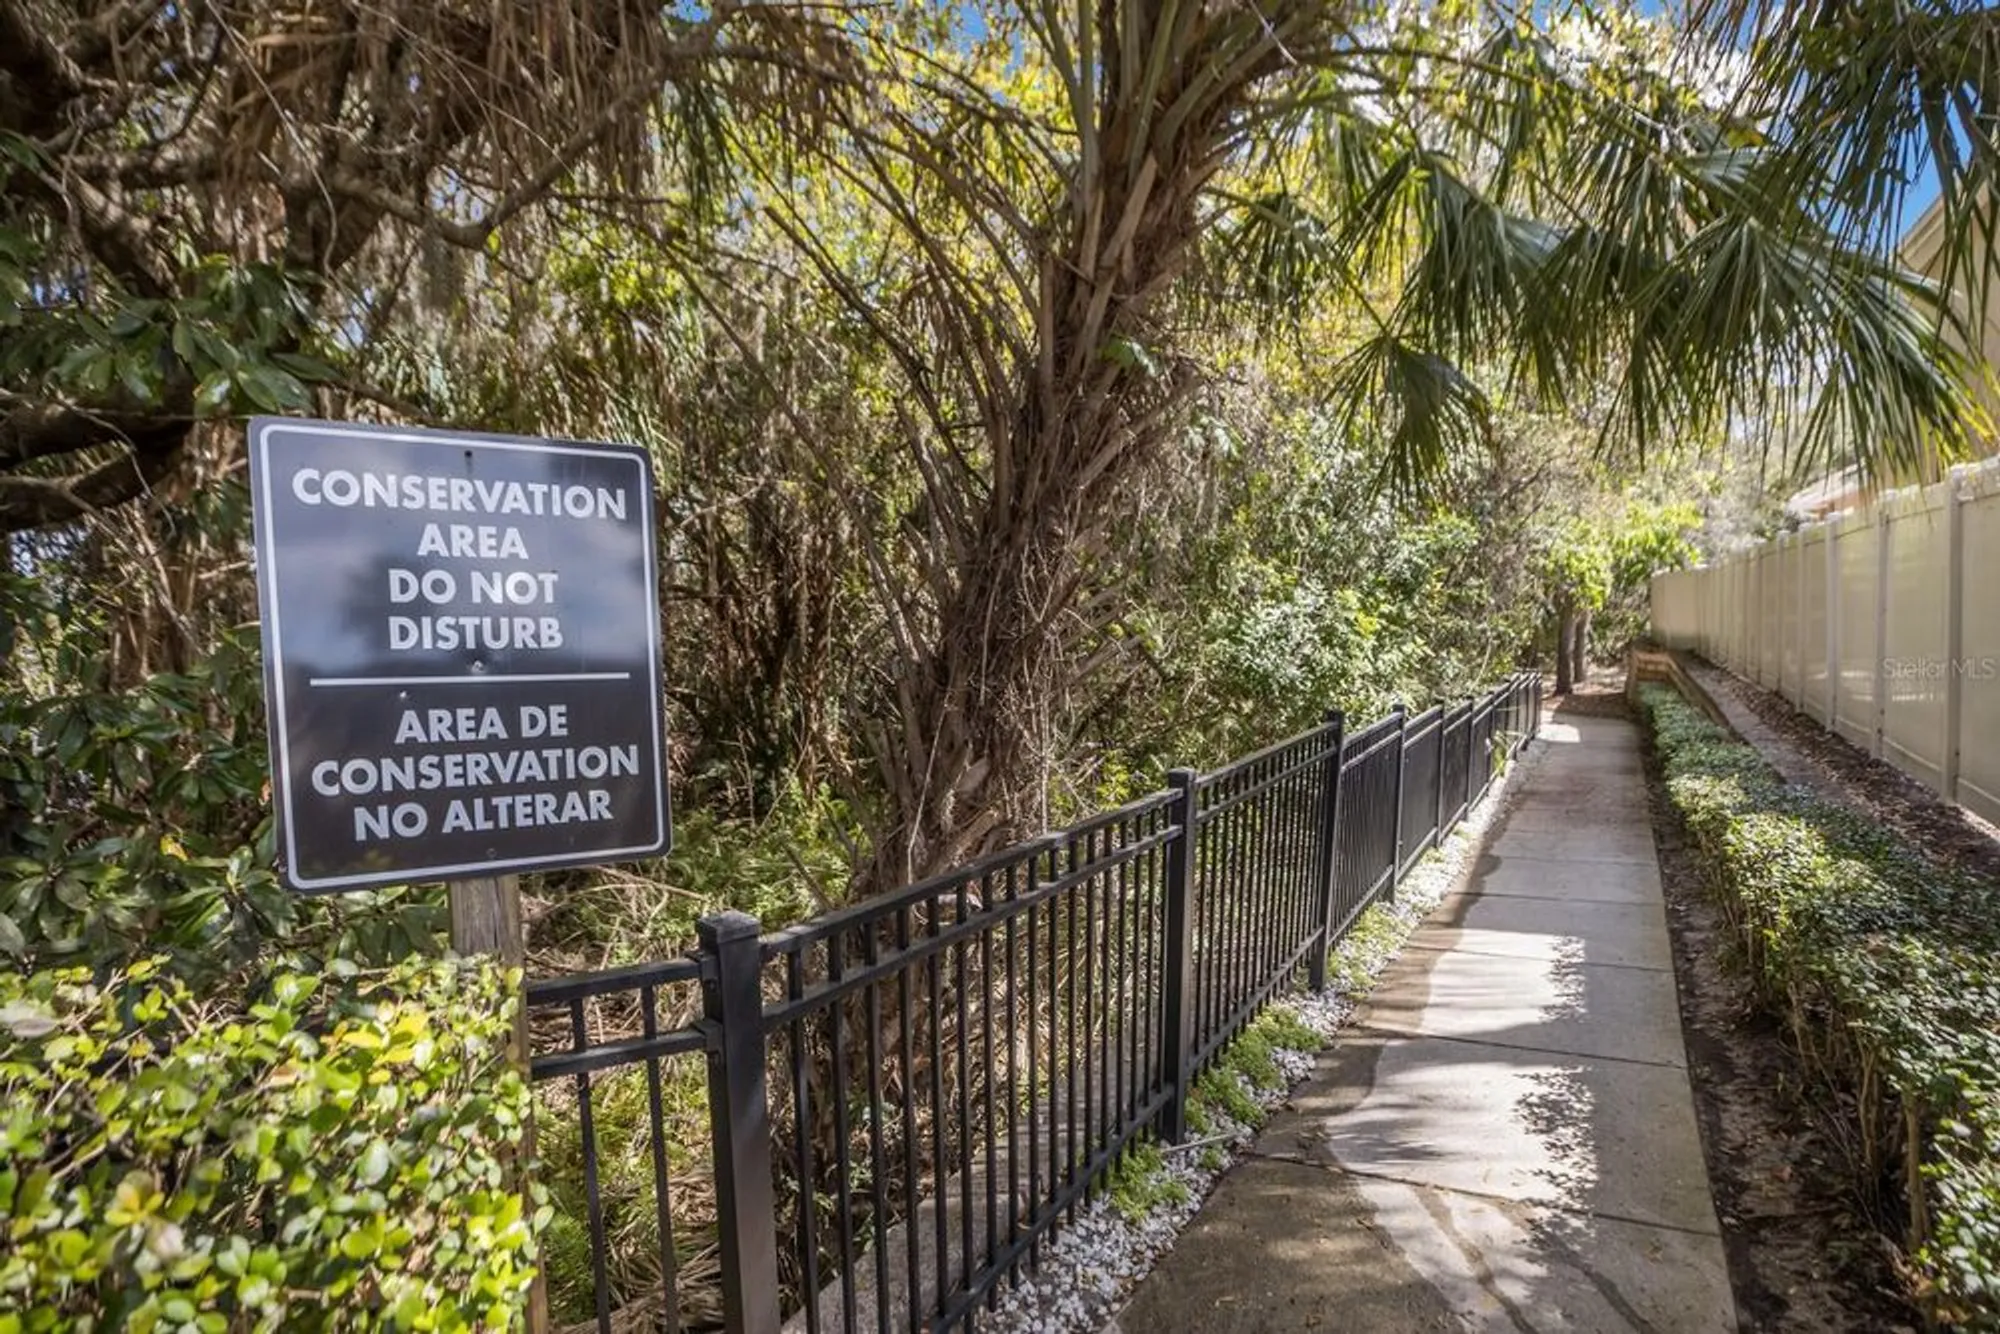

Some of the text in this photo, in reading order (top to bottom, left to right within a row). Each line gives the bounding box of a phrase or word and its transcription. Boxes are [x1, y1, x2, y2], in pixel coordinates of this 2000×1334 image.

[293, 468, 625, 520] CONSERVATION
[417, 523, 529, 560] AREA
[389, 569, 559, 604] DO NOT
[389, 616, 563, 650] DISTURB
[394, 705, 568, 744] AREA DE
[311, 744, 639, 796] CONSERVATION
[354, 789, 613, 841] NO ALTERAR
